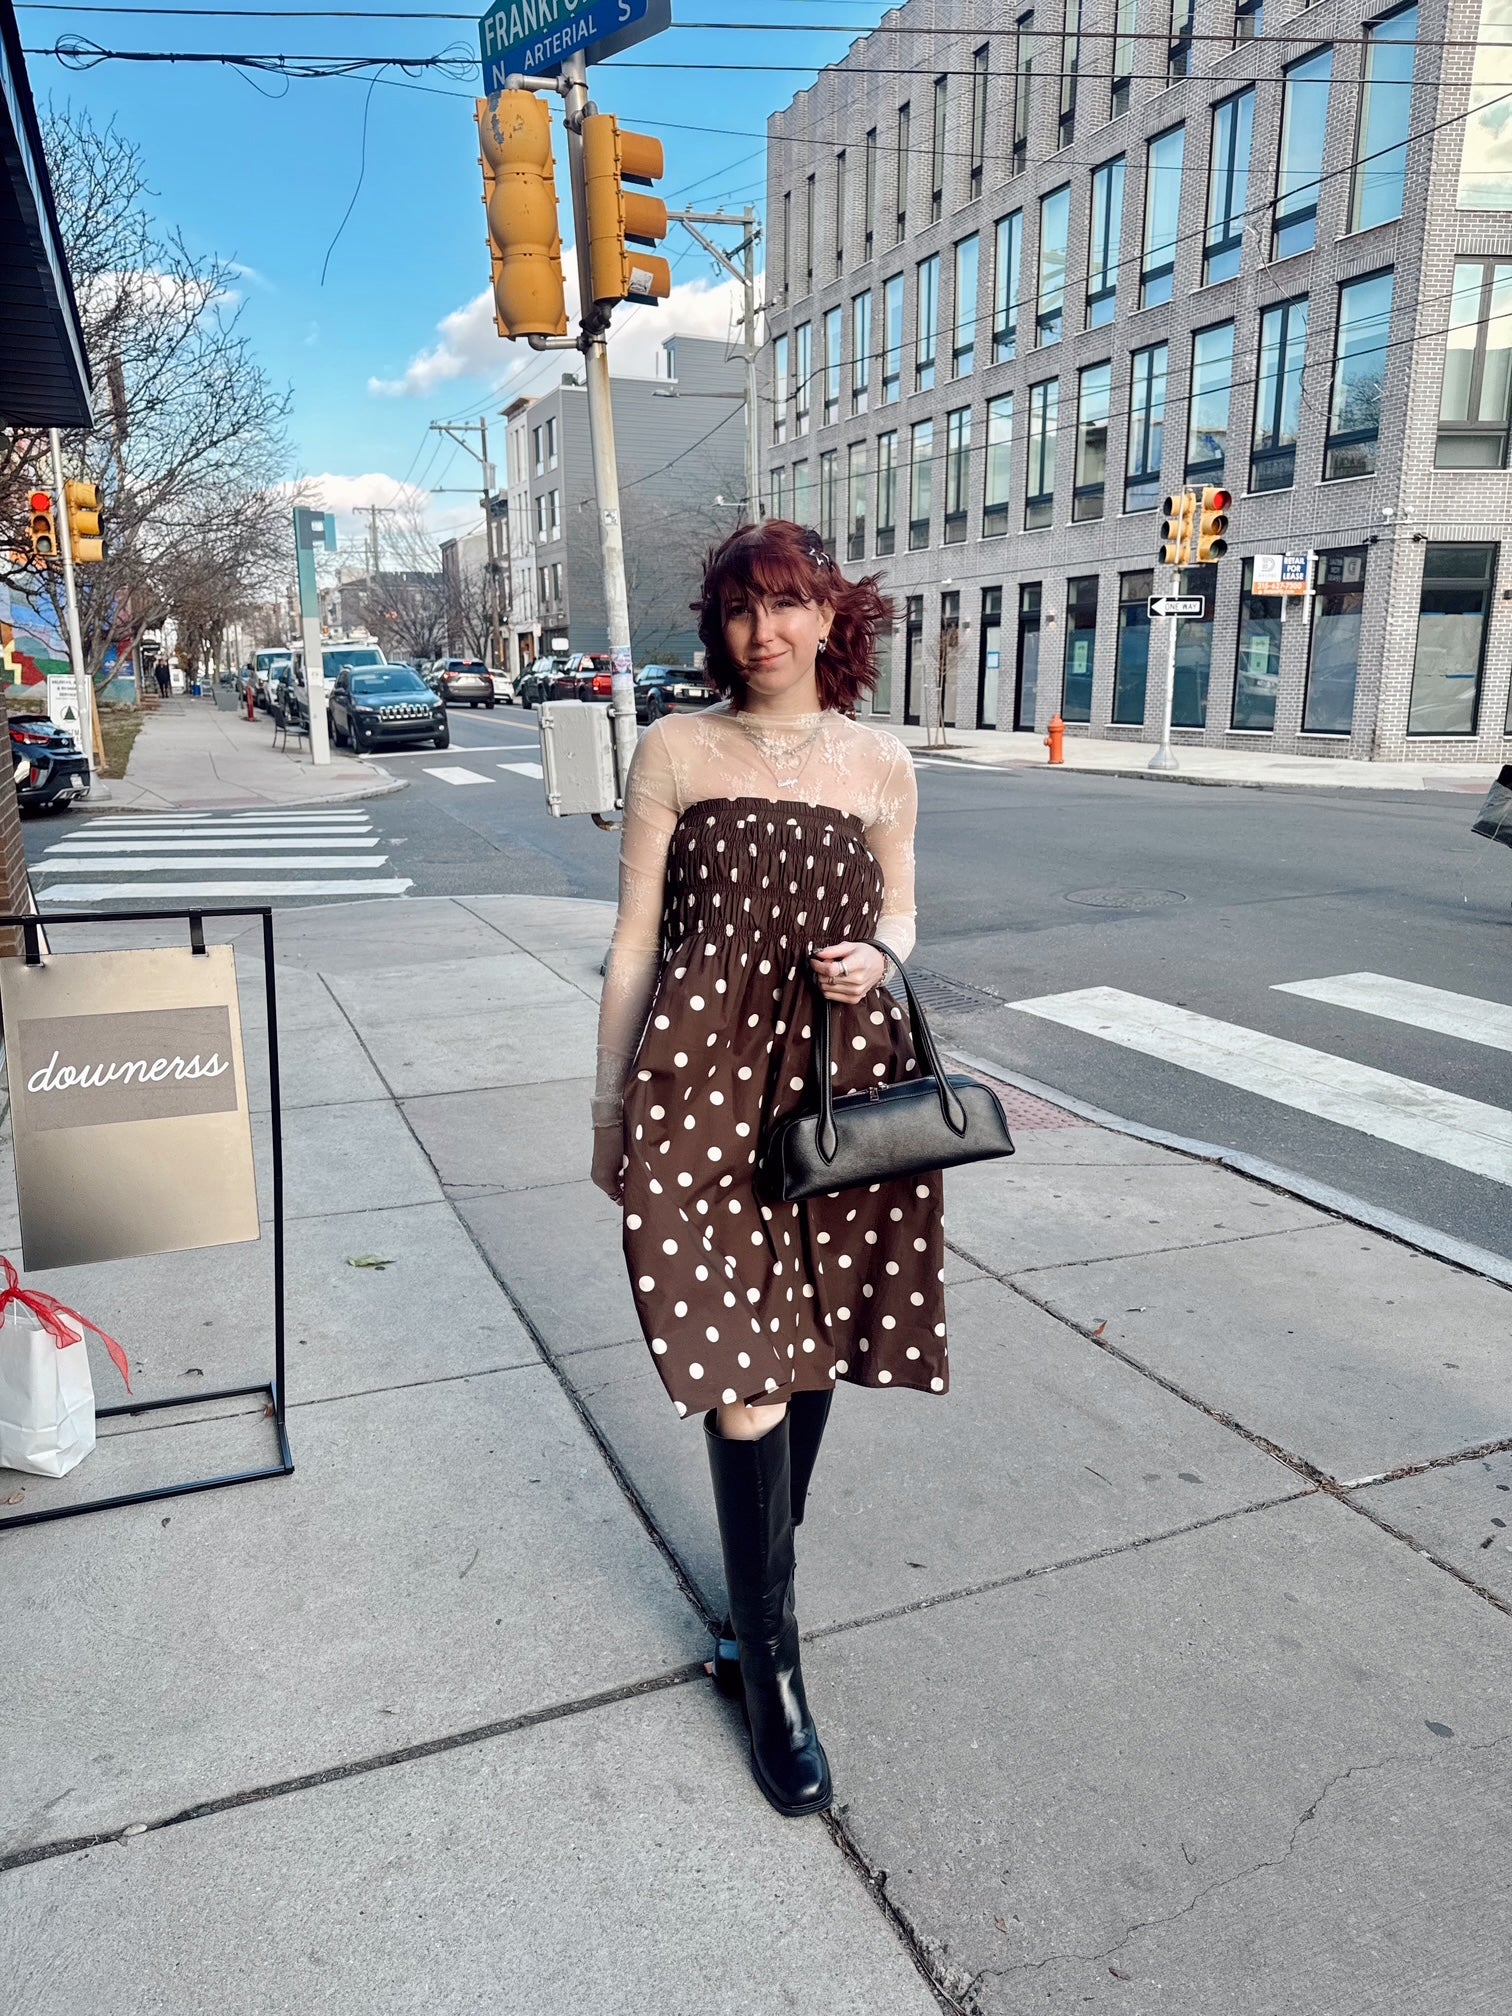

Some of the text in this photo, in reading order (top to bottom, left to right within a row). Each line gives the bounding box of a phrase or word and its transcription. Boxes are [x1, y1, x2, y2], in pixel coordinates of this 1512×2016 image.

[484, 0, 588, 56] FRANKF
[492, 0, 631, 90] N ARTERIAL S
[1283, 556, 1305, 565] RETAIL
[1286, 564, 1302, 573] FOR
[1282, 572, 1304, 581] LEASE
[1164, 602, 1180, 611] ONE
[28, 1050, 229, 1092] downerss
